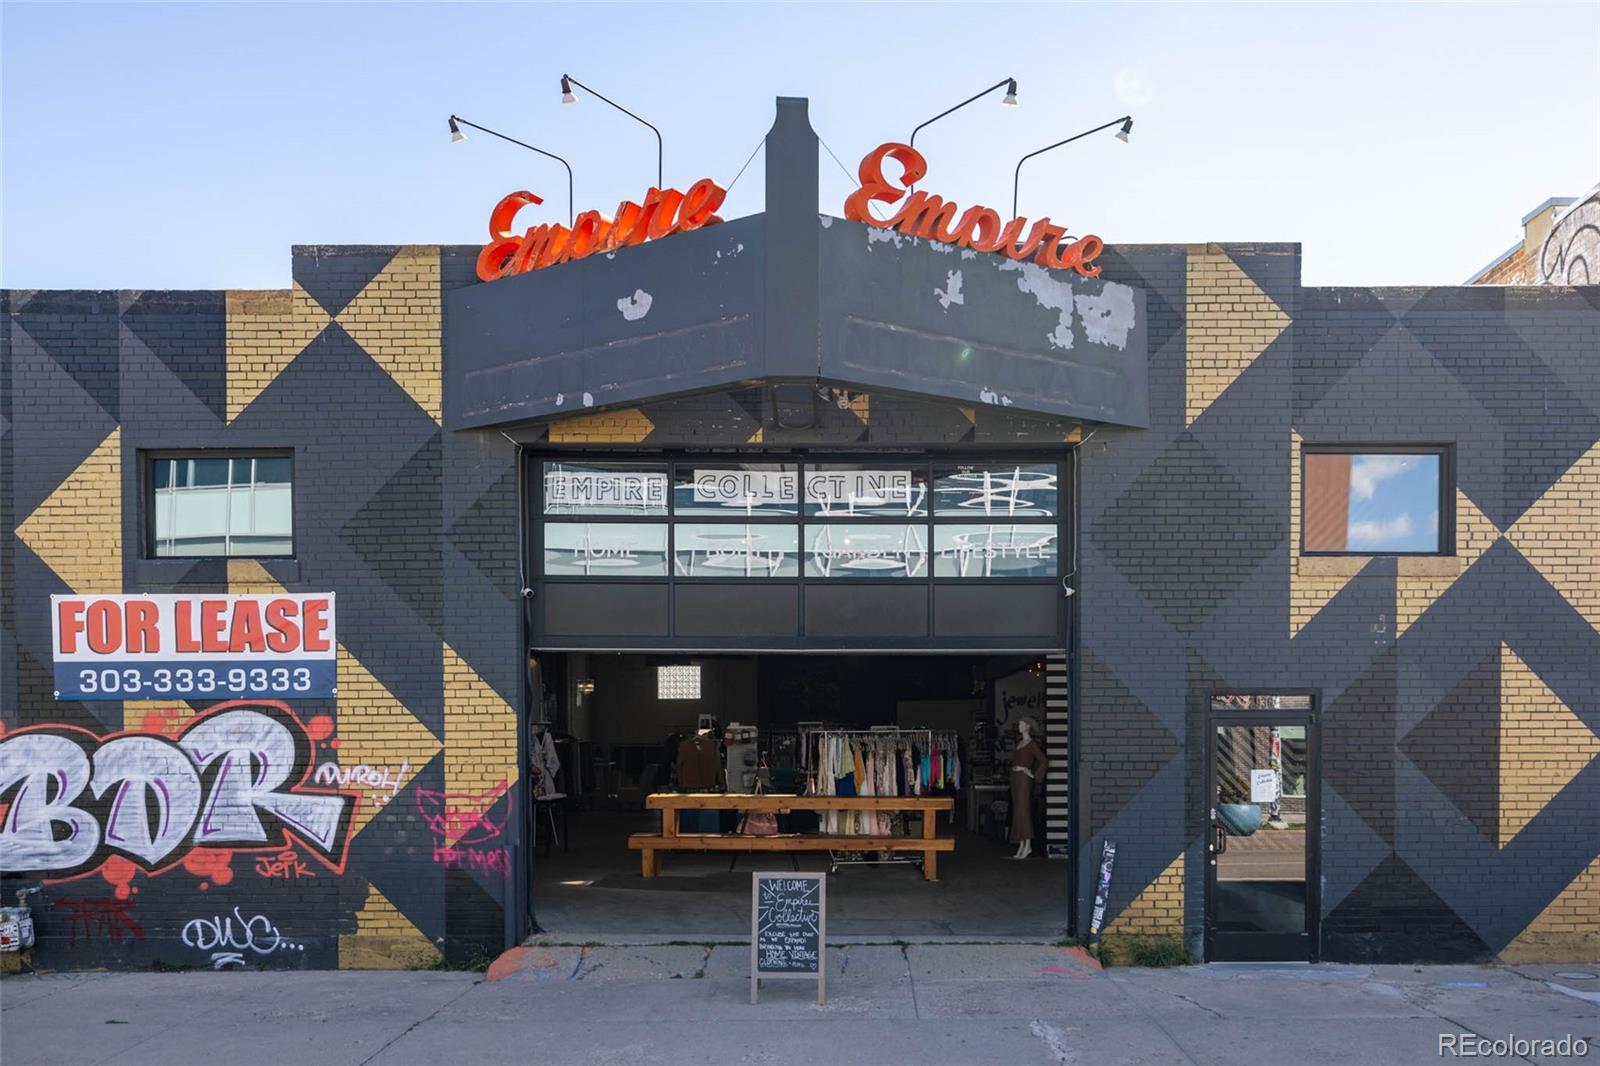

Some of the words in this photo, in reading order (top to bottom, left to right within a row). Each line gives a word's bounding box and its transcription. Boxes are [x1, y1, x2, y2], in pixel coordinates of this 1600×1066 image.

[845, 143, 1103, 277] Empire
[476, 178, 728, 283] Empire
[551, 476, 664, 501] EMPIRE
[58, 599, 160, 654] FOR
[174, 599, 331, 653] LEASE
[79, 668, 311, 692] 303-333-9333
[768, 880, 808, 892] WELCOME
